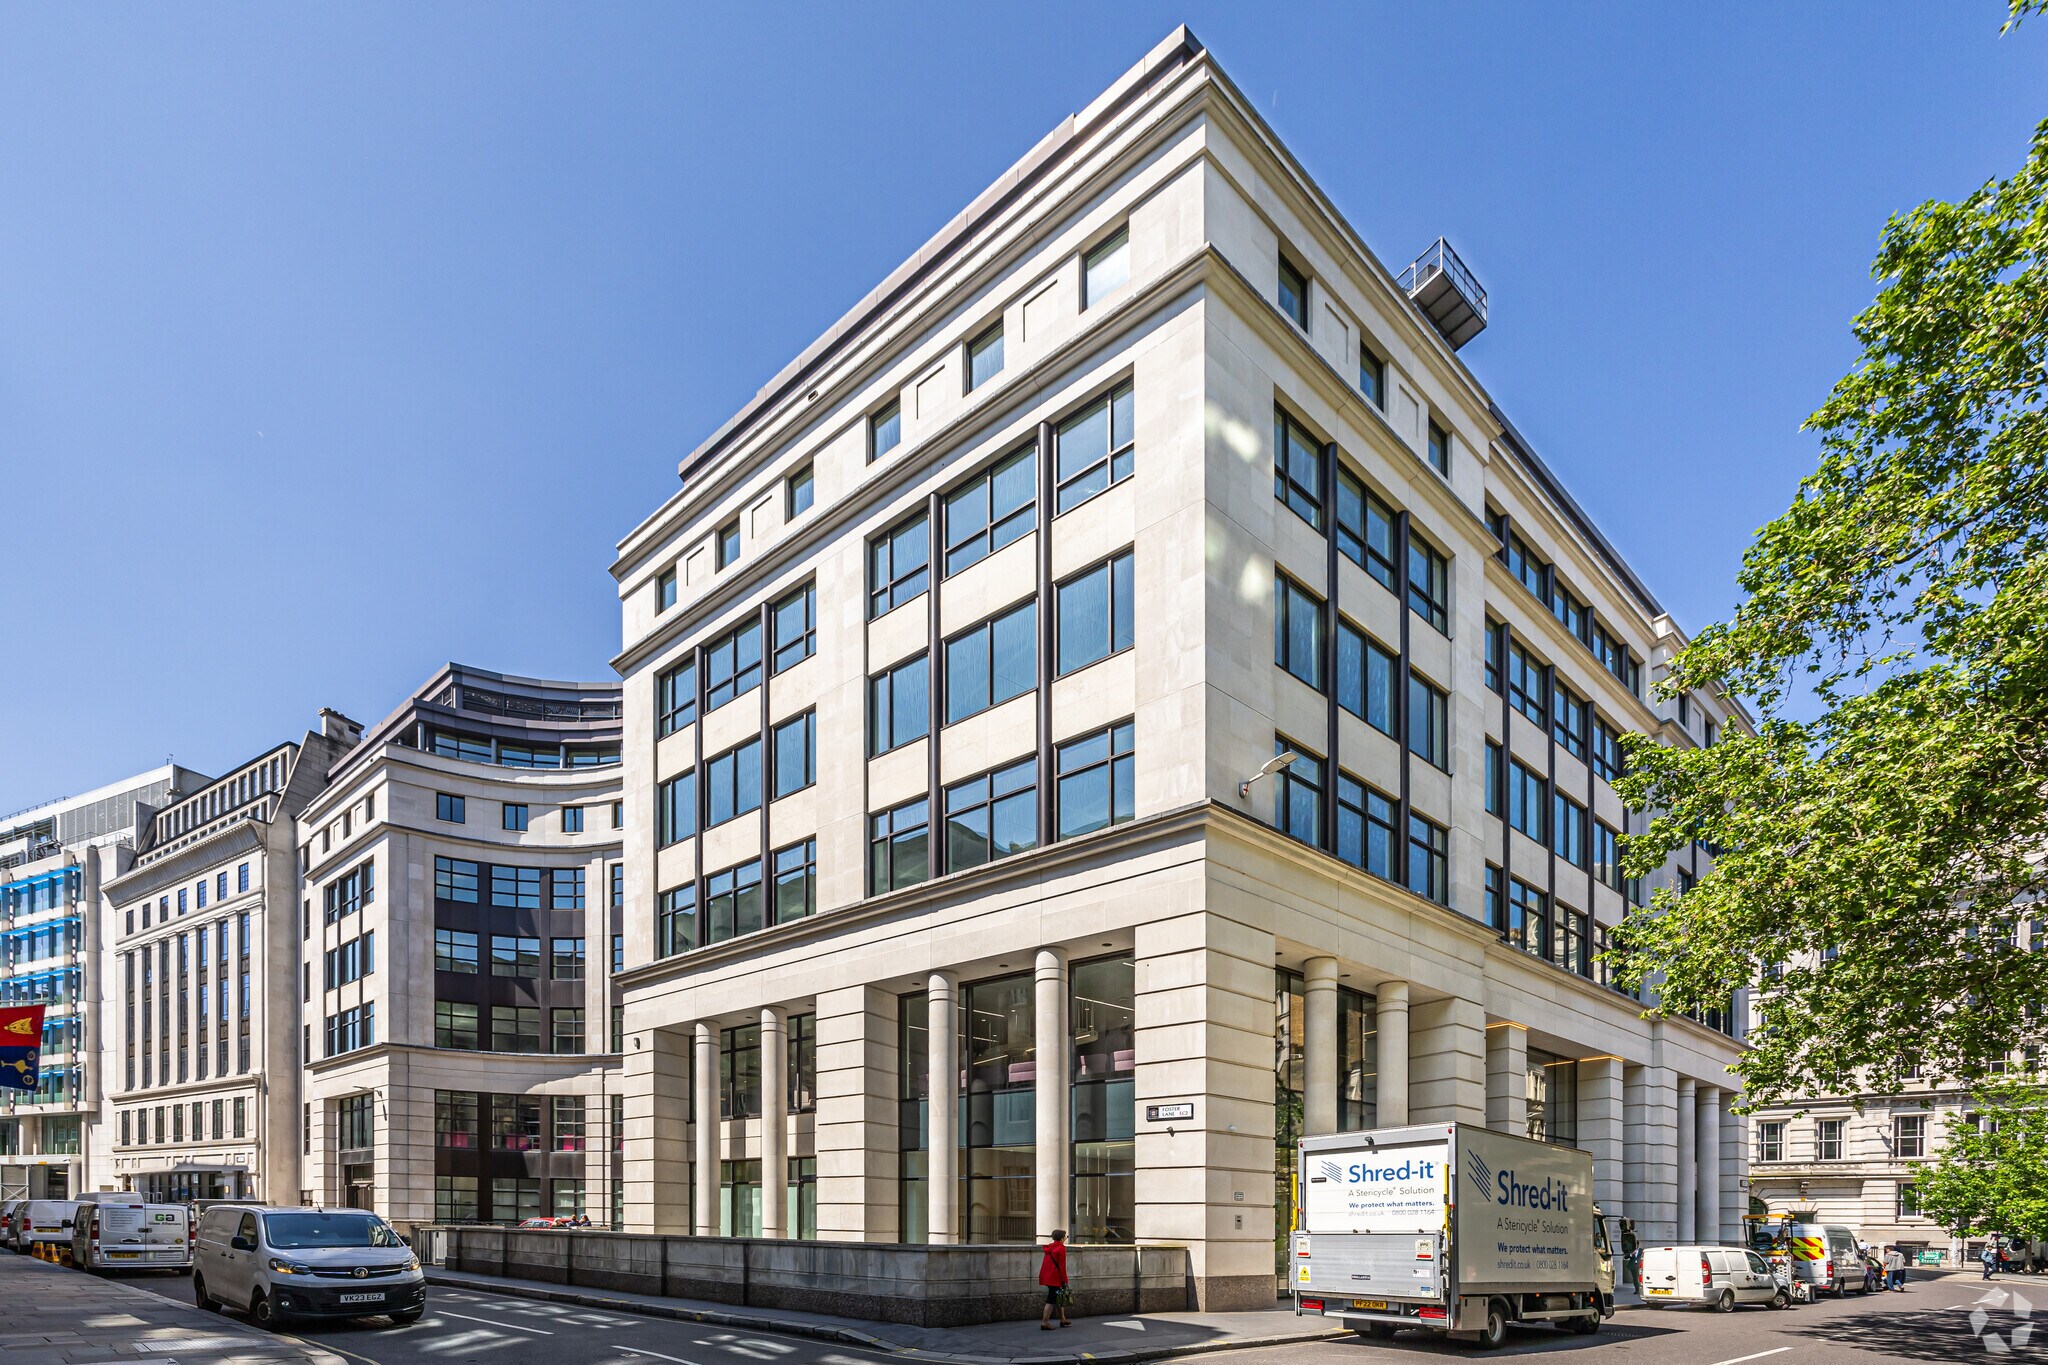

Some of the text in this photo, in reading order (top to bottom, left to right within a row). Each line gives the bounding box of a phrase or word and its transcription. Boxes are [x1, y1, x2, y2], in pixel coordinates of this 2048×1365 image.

[1348, 1160, 1434, 1183] Shred-it
[1399, 1187, 1435, 1195] Solution
[1497, 1169, 1568, 1213] Shred-it
[1497, 1217, 1503, 1230] A
[1542, 1220, 1569, 1234] Solution
[1497, 1242, 1568, 1255] We protect what matters.
[1497, 1259, 1569, 1270] shredit.co.uk 0800 028 1164
